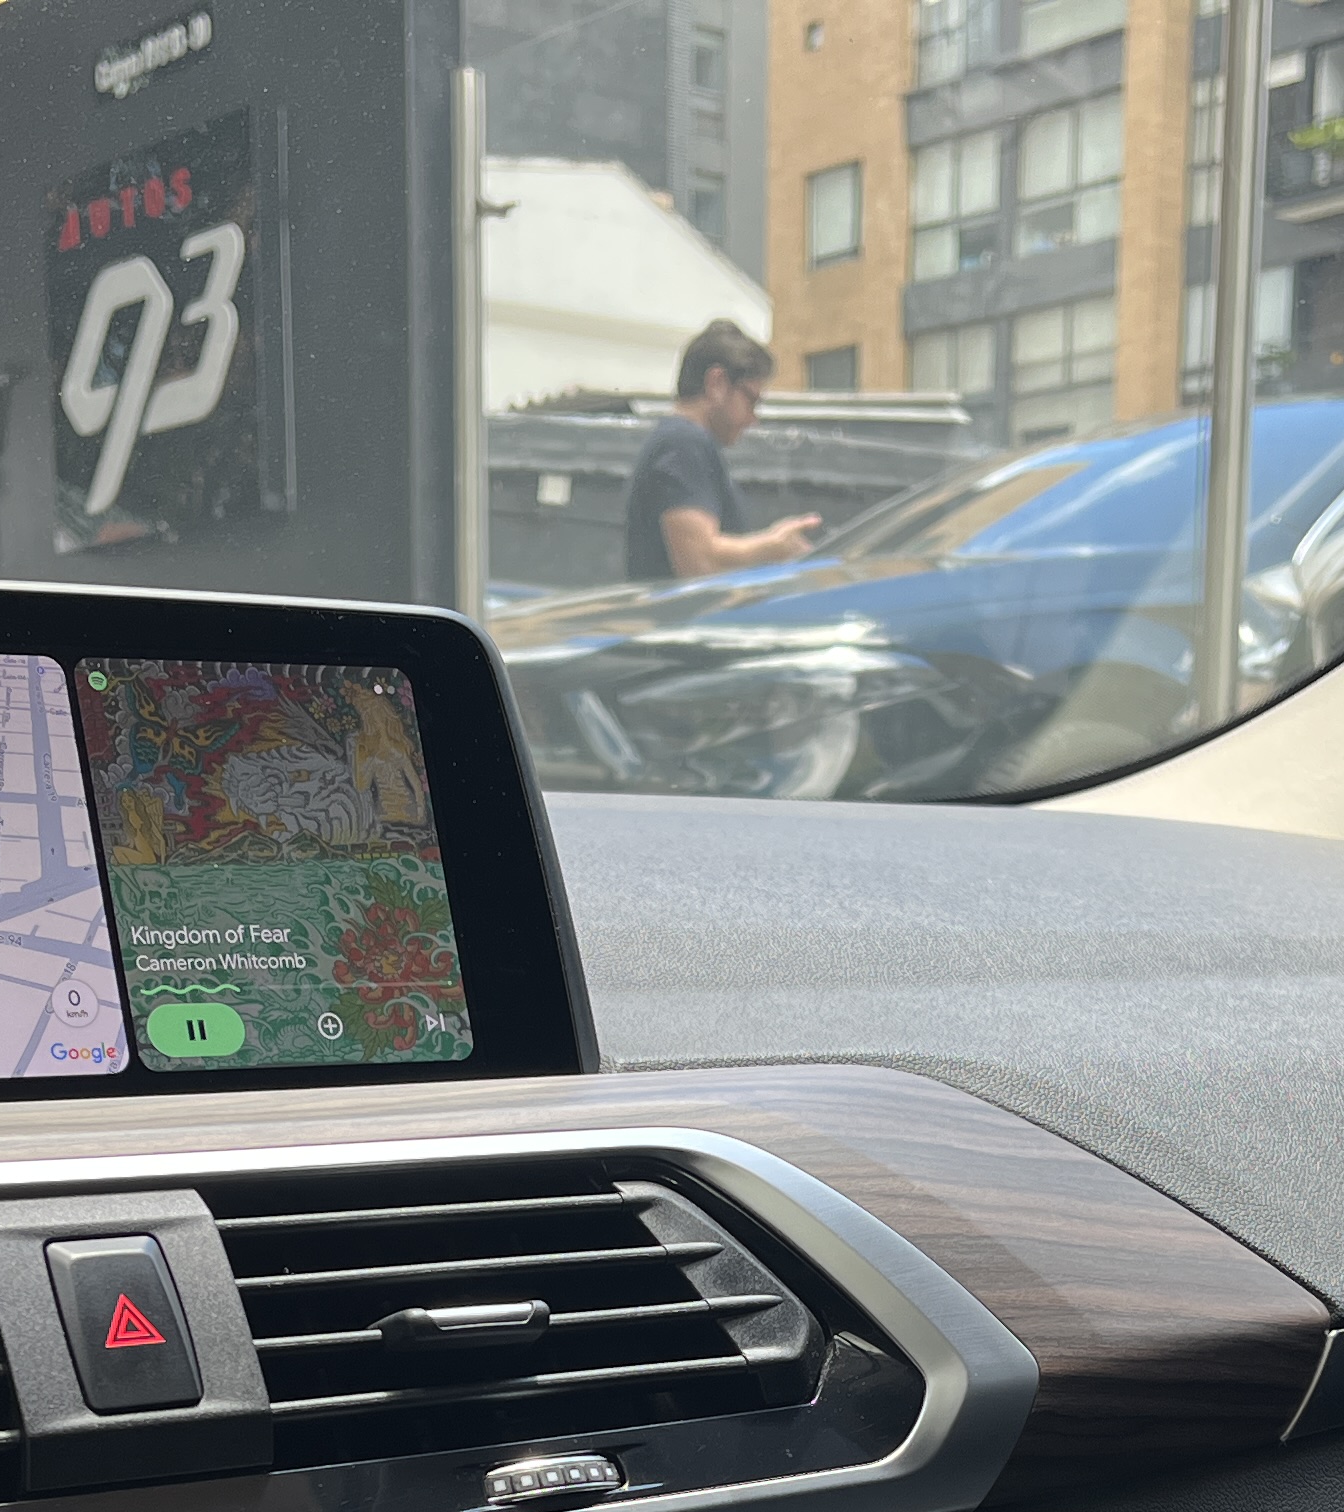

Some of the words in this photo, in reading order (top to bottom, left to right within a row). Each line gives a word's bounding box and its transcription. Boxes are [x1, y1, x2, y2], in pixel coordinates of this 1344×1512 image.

[59, 168, 192, 252] AUTOS
[61, 222, 245, 515] 93
[7, 934, 22, 947] 94
[131, 926, 220, 949] Kingdom
[225, 925, 244, 943] of
[250, 924, 291, 943] Fear
[136, 954, 216, 972] Cameron
[218, 953, 306, 970] Whitcomb
[68, 990, 80, 1006] 0
[66, 1009, 89, 1018] km/h
[51, 1042, 116, 1063] Google
